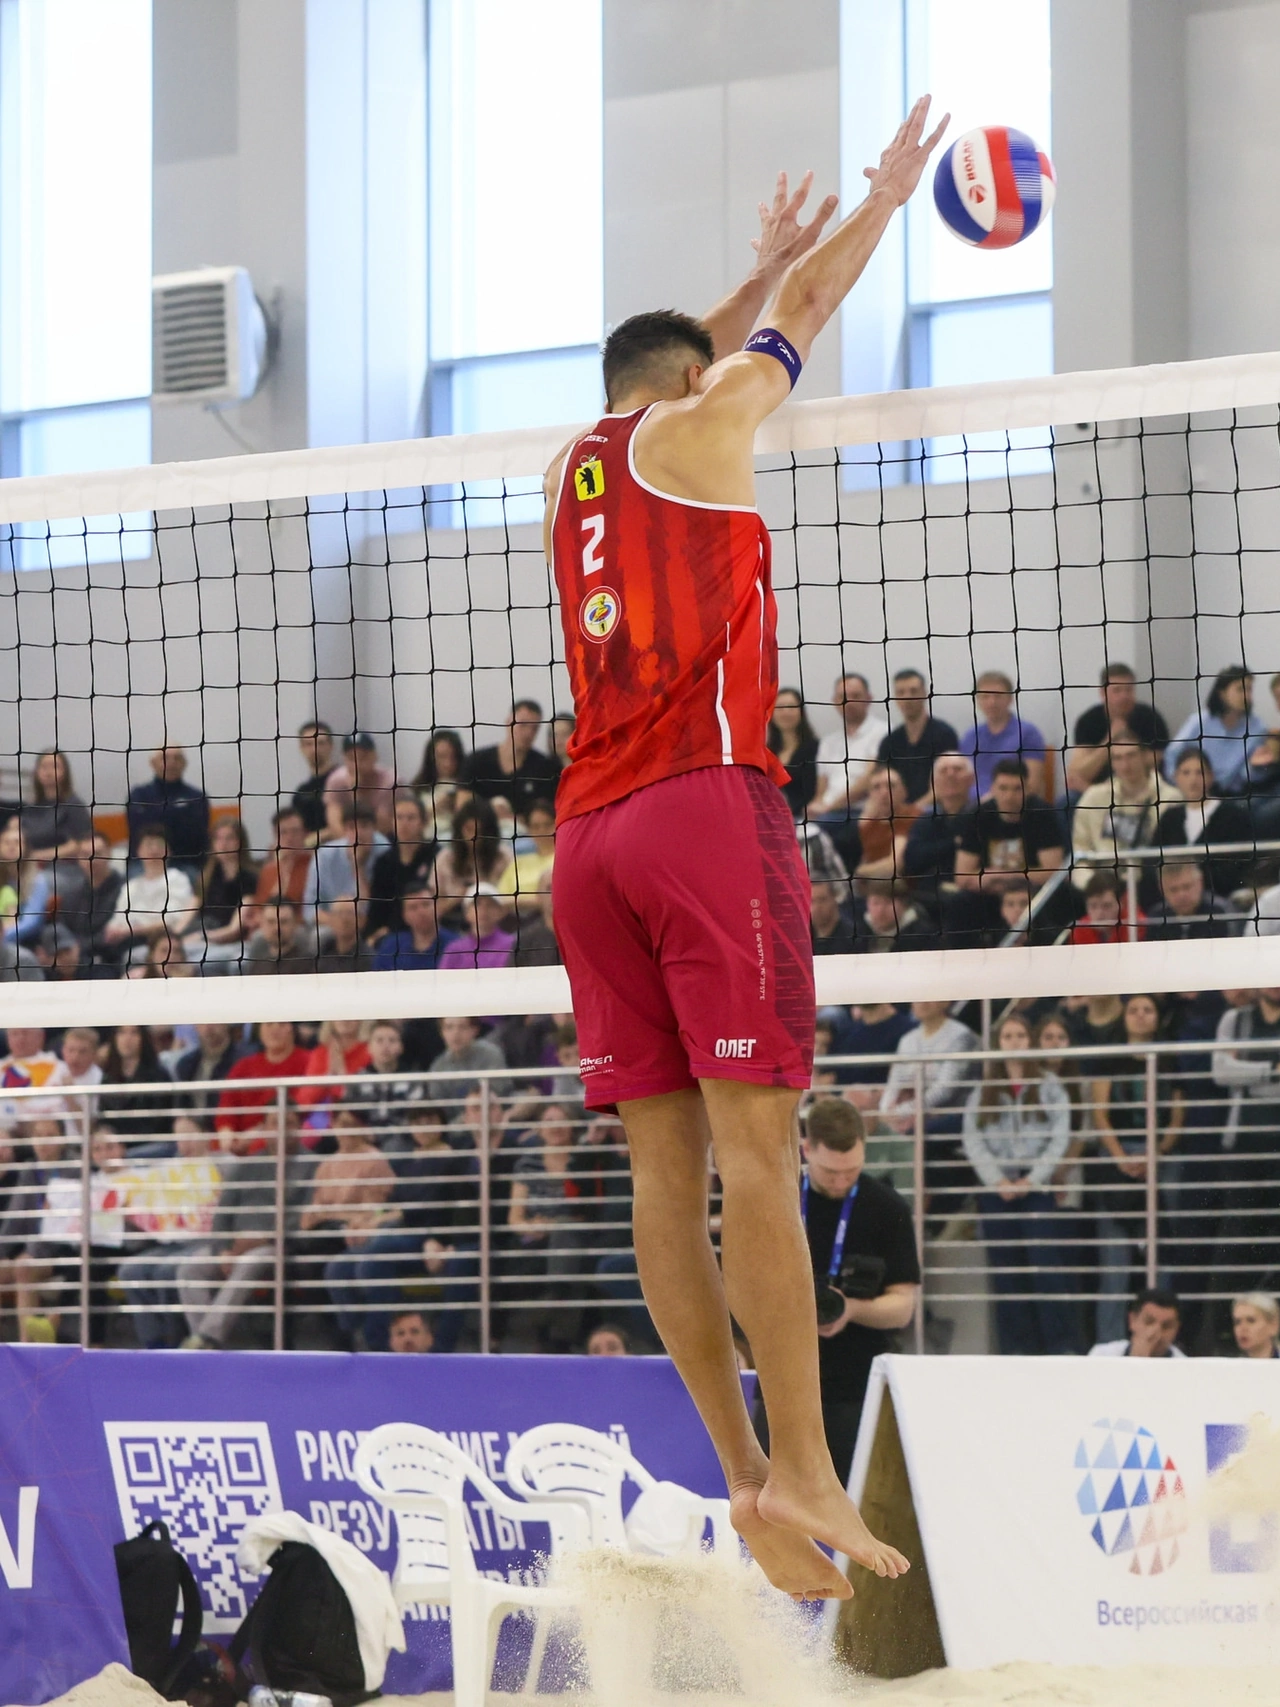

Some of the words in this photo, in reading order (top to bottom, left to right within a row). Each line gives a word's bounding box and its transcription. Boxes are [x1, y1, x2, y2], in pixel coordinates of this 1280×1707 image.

[581, 514, 605, 577] 2
[715, 1038, 757, 1058] ОЛЕГ
[1097, 1599, 1258, 1631] Всероссийская
